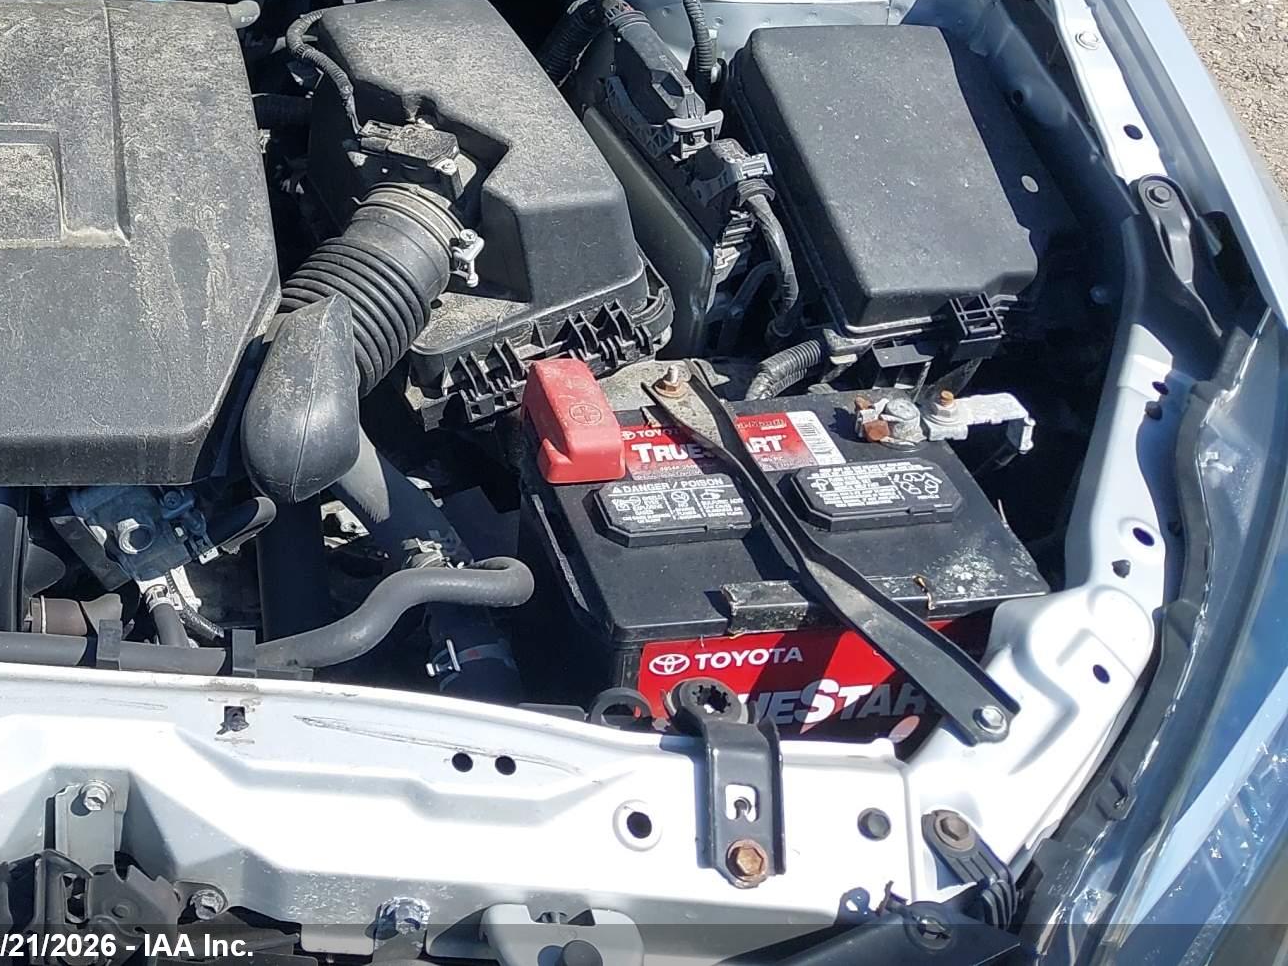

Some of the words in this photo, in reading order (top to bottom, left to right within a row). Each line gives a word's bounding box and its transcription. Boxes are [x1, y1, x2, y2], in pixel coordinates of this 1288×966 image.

[636, 427, 680, 439] TOYOT
[623, 482, 670, 493] DANGER
[681, 478, 724, 488] POISON
[695, 647, 803, 671] TOYOTA
